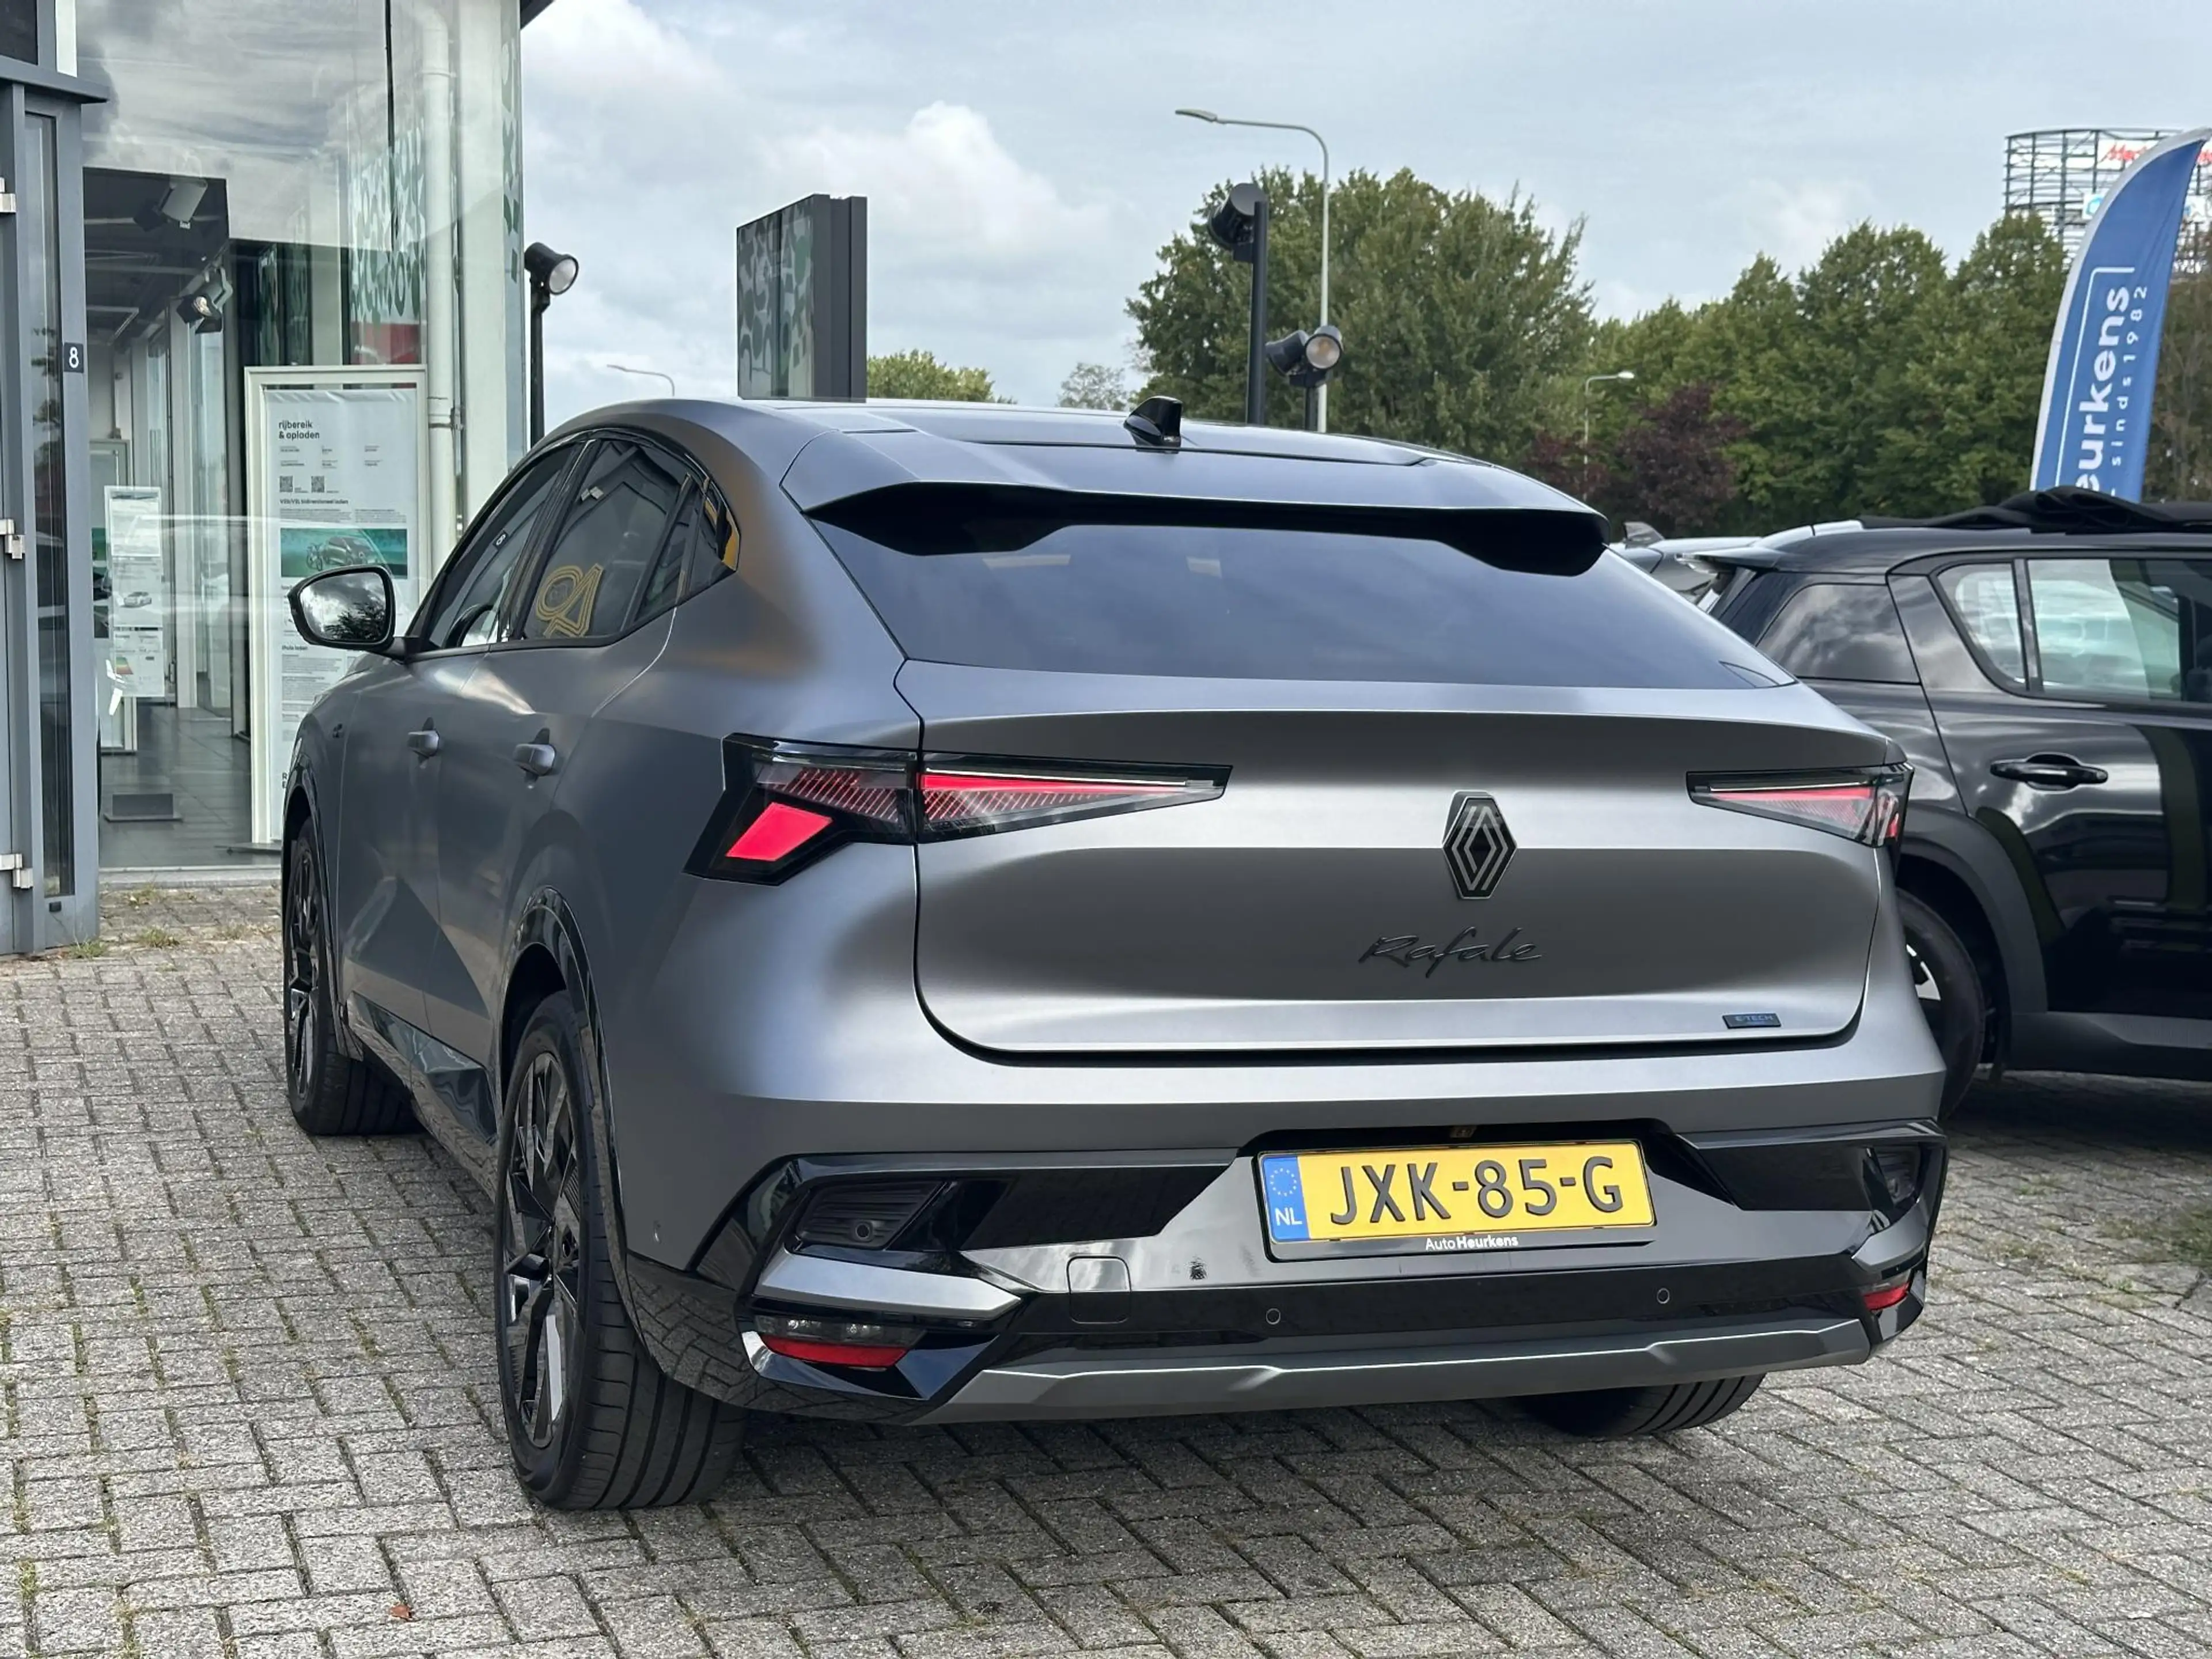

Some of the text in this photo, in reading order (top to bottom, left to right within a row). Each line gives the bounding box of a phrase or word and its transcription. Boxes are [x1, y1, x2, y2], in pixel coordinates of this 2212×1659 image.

[69, 346, 79, 368] 8
[278, 420, 313, 430] rijbereik
[279, 431, 320, 441] & opladen
[1358, 926, 1542, 978] Rafale
[1330, 1156, 1623, 1225] JXK-85-G
[1275, 1208, 1302, 1226] NL
